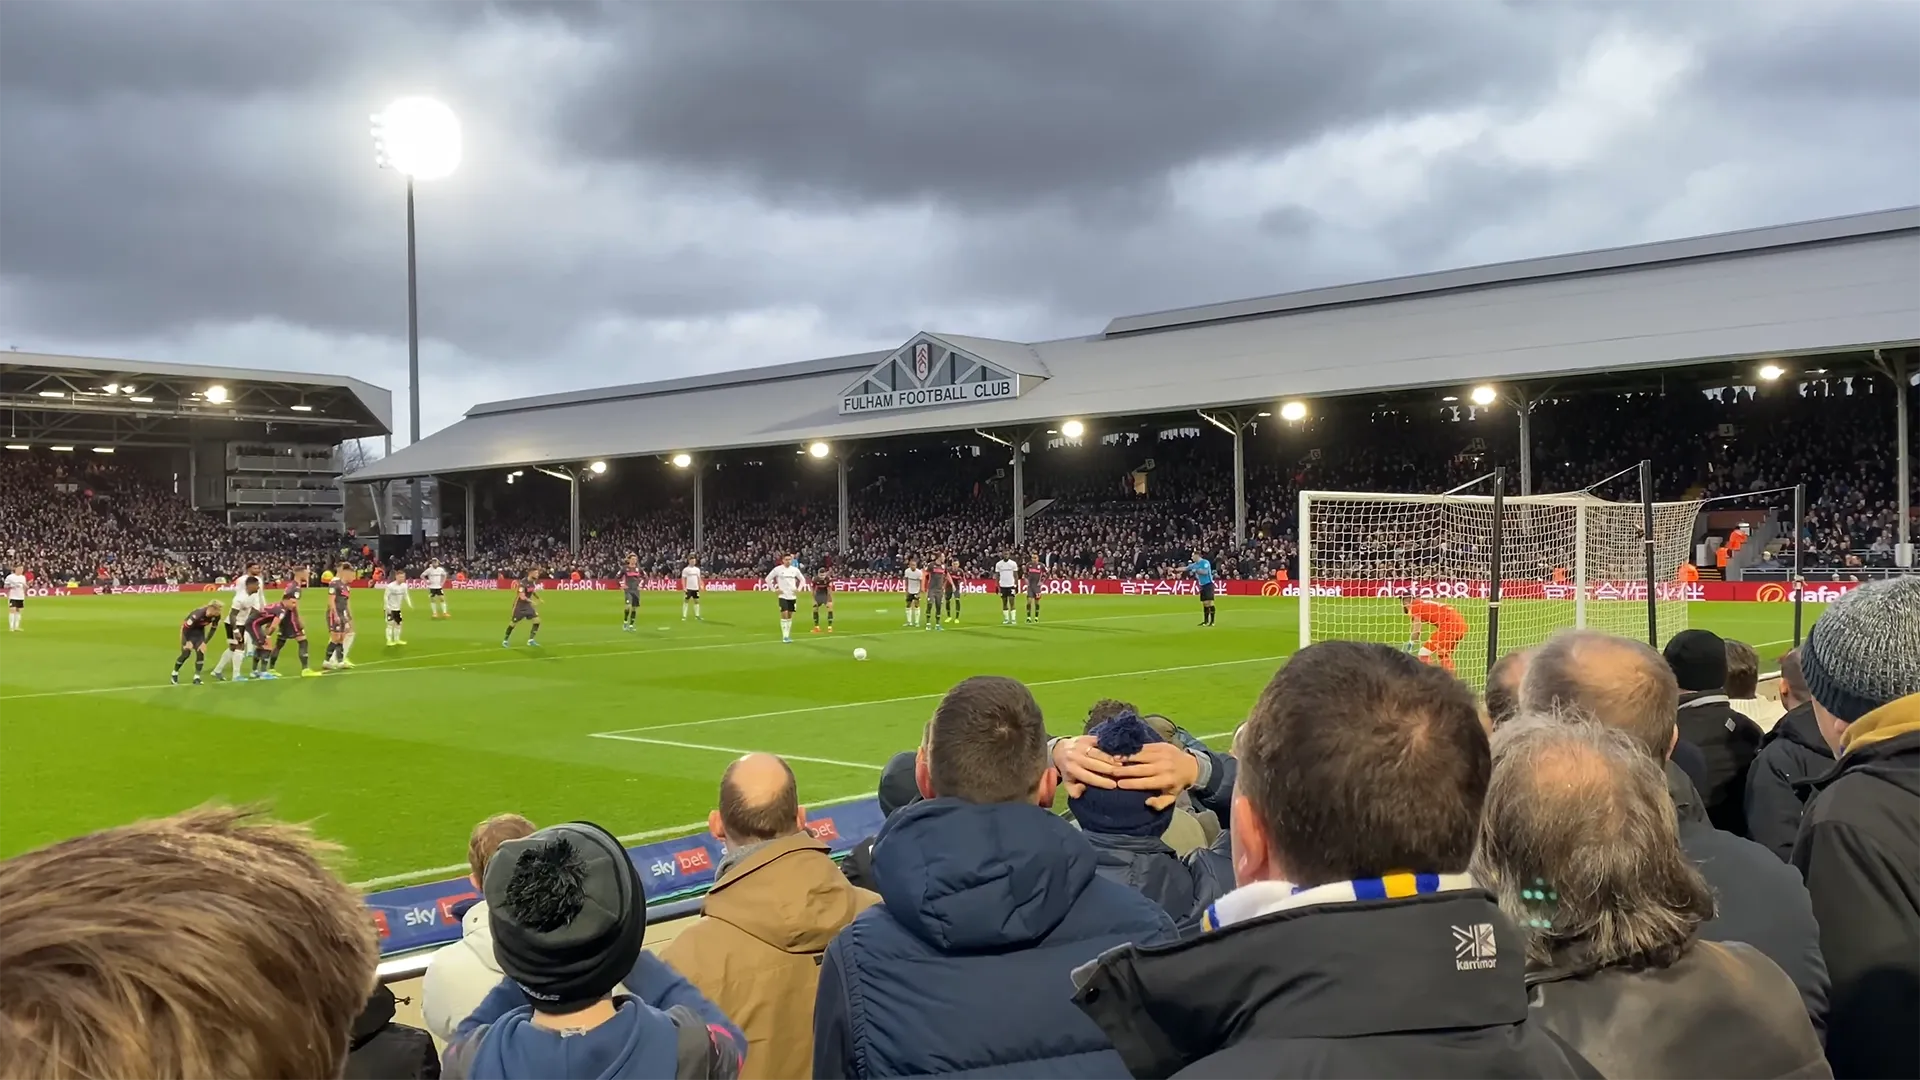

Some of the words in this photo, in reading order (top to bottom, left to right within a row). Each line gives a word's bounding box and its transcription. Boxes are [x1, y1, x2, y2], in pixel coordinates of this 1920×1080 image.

[844, 395, 893, 411] FULHAM
[900, 386, 967, 405] FOOTBALL
[974, 381, 1011, 398] CLUB
[705, 581, 737, 591] dafabet
[1282, 584, 1342, 597] daabet
[651, 860, 676, 876] sky
[678, 852, 708, 869] bet
[404, 907, 437, 926] sky
